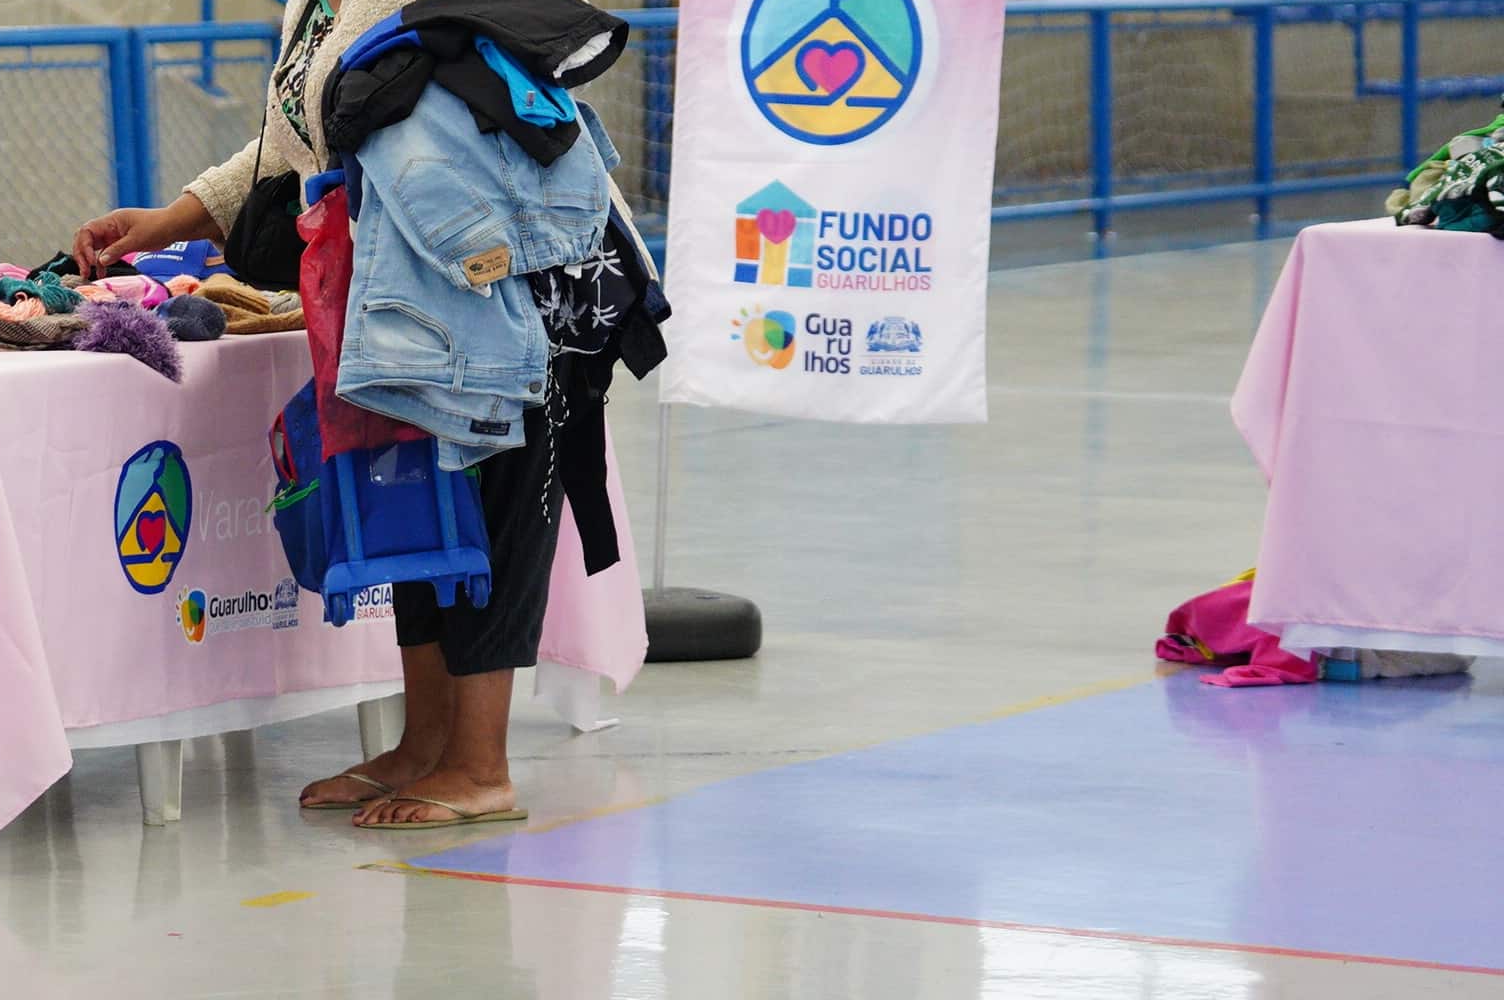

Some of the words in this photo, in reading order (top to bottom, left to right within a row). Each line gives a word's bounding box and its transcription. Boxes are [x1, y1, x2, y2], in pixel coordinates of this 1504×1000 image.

[818, 210, 933, 242] FUNDO
[816, 245, 932, 273] SOCIAL
[816, 272, 932, 291] GUARULHOS
[805, 313, 852, 337] Gua
[826, 337, 852, 355] ru
[804, 351, 851, 375] lhos
[357, 586, 393, 607] SOCIA
